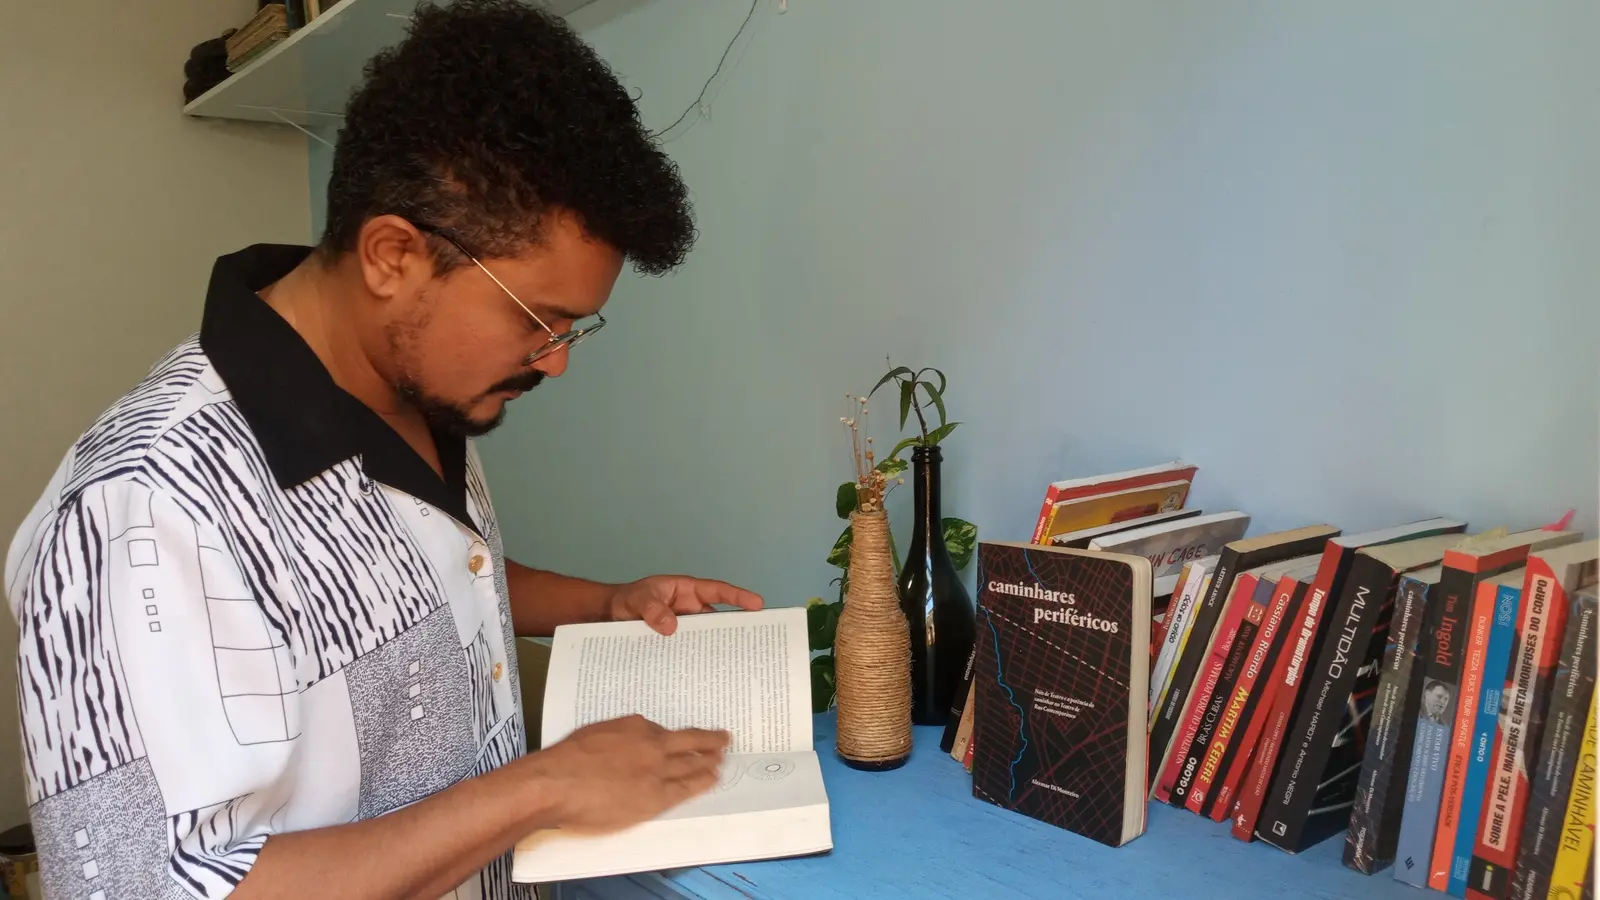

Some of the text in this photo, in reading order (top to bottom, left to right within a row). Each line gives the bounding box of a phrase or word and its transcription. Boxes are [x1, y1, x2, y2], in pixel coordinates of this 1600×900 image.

[1167, 544, 1205, 564] CAGE
[988, 581, 1076, 604] caminhares
[1216, 566, 1227, 588] ARTHUR
[1308, 588, 1325, 616] Tempo
[1533, 580, 1547, 614] CORPO
[1034, 608, 1119, 633] periféricos
[1264, 593, 1289, 638] Cassiano
[1328, 586, 1370, 679] MULTIDÃO
[1393, 590, 1413, 670] caminhares periféricos
[1436, 595, 1457, 667] Tim Ingold
[1530, 617, 1540, 631] DO
[1222, 628, 1238, 651] Bocage
[1285, 627, 1312, 686] Dramaturgias
[1247, 640, 1269, 678] Ricardo
[1513, 634, 1537, 715] METAMORFOSES
[1458, 616, 1486, 747] DUNKER TEZZA FUKS TIBURI SAFATLE
[1567, 656, 1580, 697] periféricos
[1219, 686, 1249, 738] MARTIM
[1316, 680, 1332, 710] Michael
[1176, 662, 1222, 766] SONETOS E OUTROS POEMAS
[1197, 695, 1223, 745] BRÁS CUBAS
[1305, 712, 1320, 742] HARDT
[1200, 741, 1226, 784] CERERÊ
[1292, 749, 1306, 778] Antonio
[1503, 726, 1520, 773] IMAGENS
[1180, 757, 1197, 787] GLOBO
[1497, 776, 1510, 802] PELE.
[1283, 780, 1296, 805] NEGRI
[1495, 803, 1505, 812] A
[1563, 753, 1596, 852] CAMINHÁVEL
[1489, 813, 1503, 845] SOBRE
